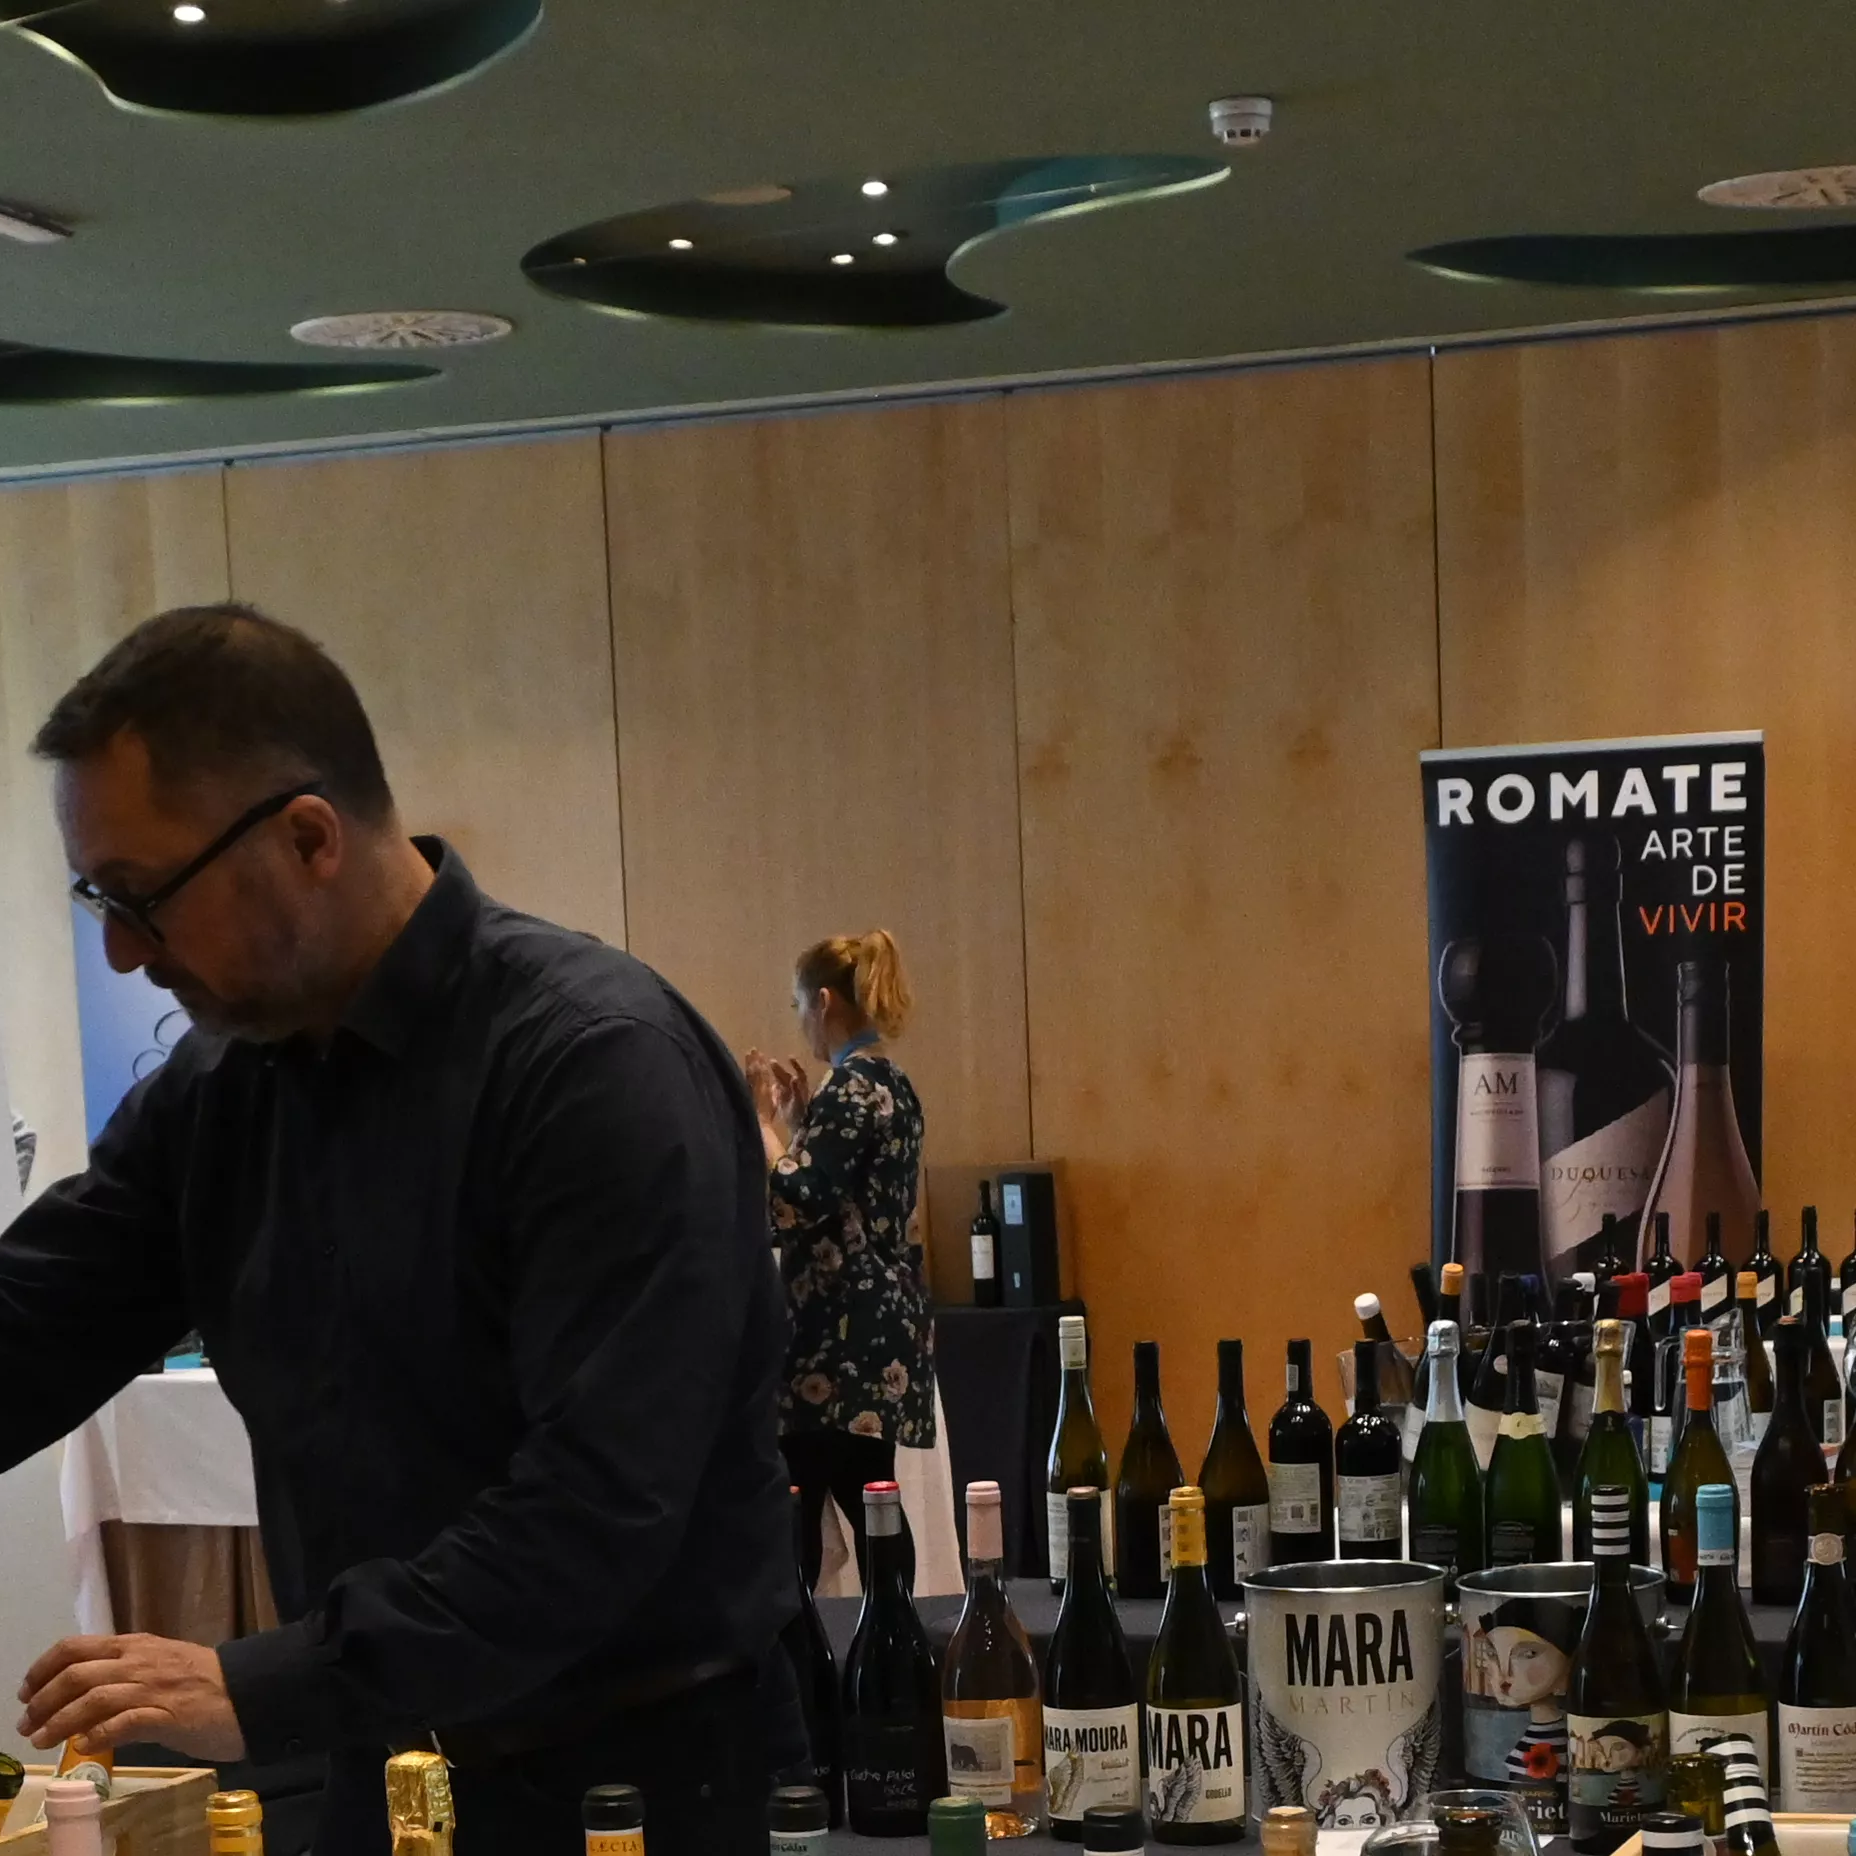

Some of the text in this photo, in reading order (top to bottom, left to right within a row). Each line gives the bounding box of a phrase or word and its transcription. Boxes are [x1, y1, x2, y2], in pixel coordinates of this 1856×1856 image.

[1437, 762, 1748, 827] ROMATE
[1640, 825, 1746, 862] ARTE
[1692, 863, 1746, 897] DE
[1639, 901, 1747, 935] VIVIR
[1474, 1070, 1519, 1097] AM
[1285, 1608, 1414, 1687] MARA
[1288, 1688, 1414, 1716] MARTÍN
[1075, 1723, 1128, 1753] MOURA
[1148, 1711, 1233, 1770] MARA
[1527, 1800, 1564, 1820] riet
[1600, 1810, 1642, 1823] Mariet
